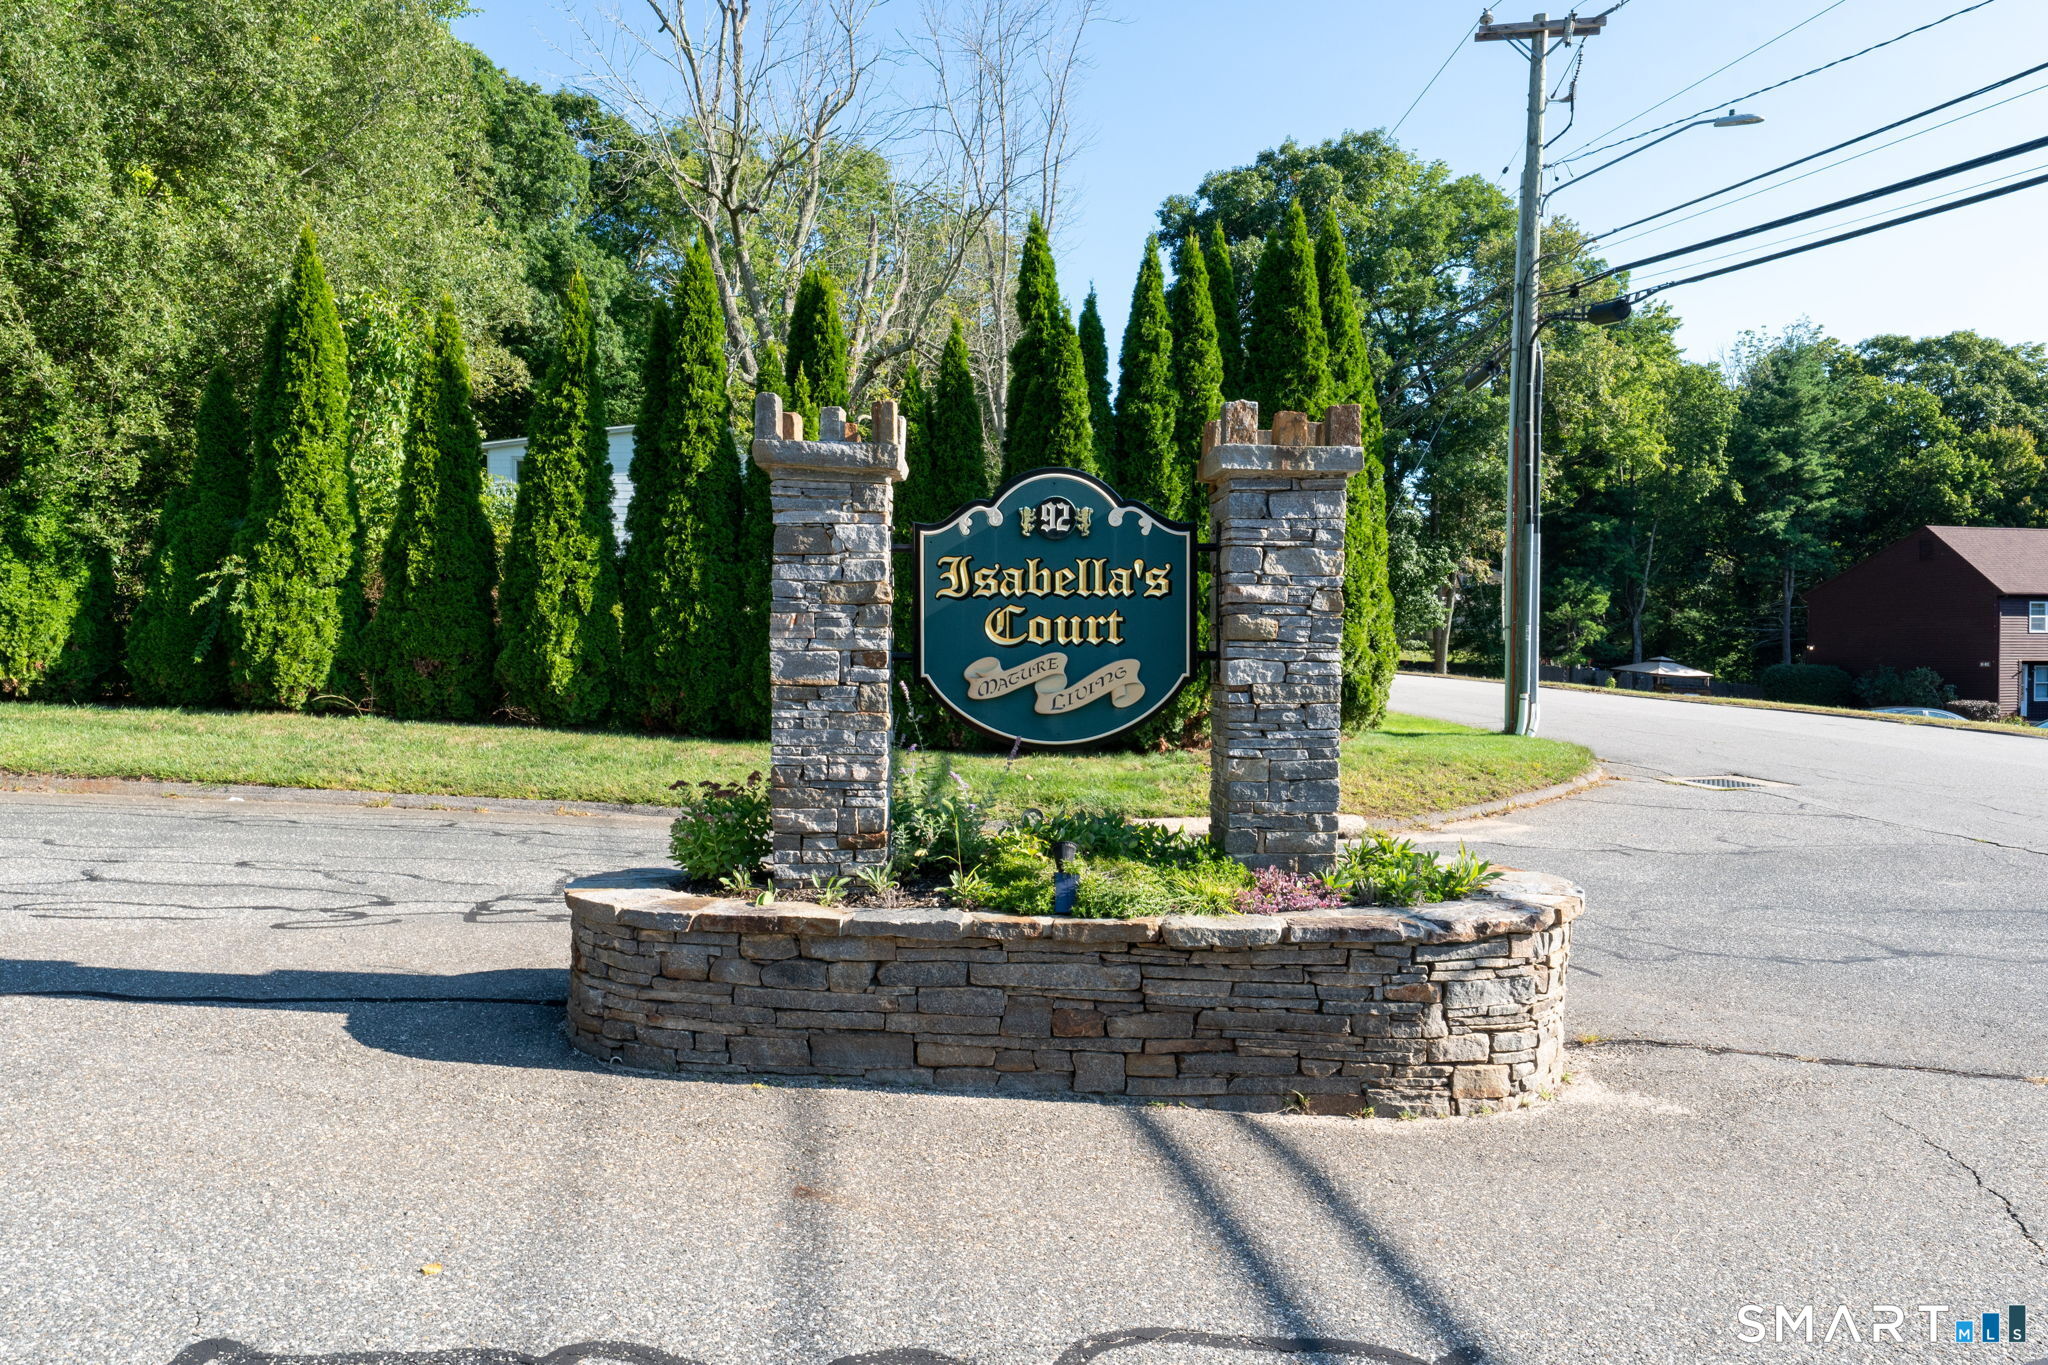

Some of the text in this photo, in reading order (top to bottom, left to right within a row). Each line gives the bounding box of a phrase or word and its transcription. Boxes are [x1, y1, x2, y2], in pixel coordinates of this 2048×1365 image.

[1040, 501, 1071, 532] 92
[935, 555, 1172, 599] Isabella's
[984, 604, 1125, 646] Court
[977, 657, 1127, 711] MATURE LIVING
